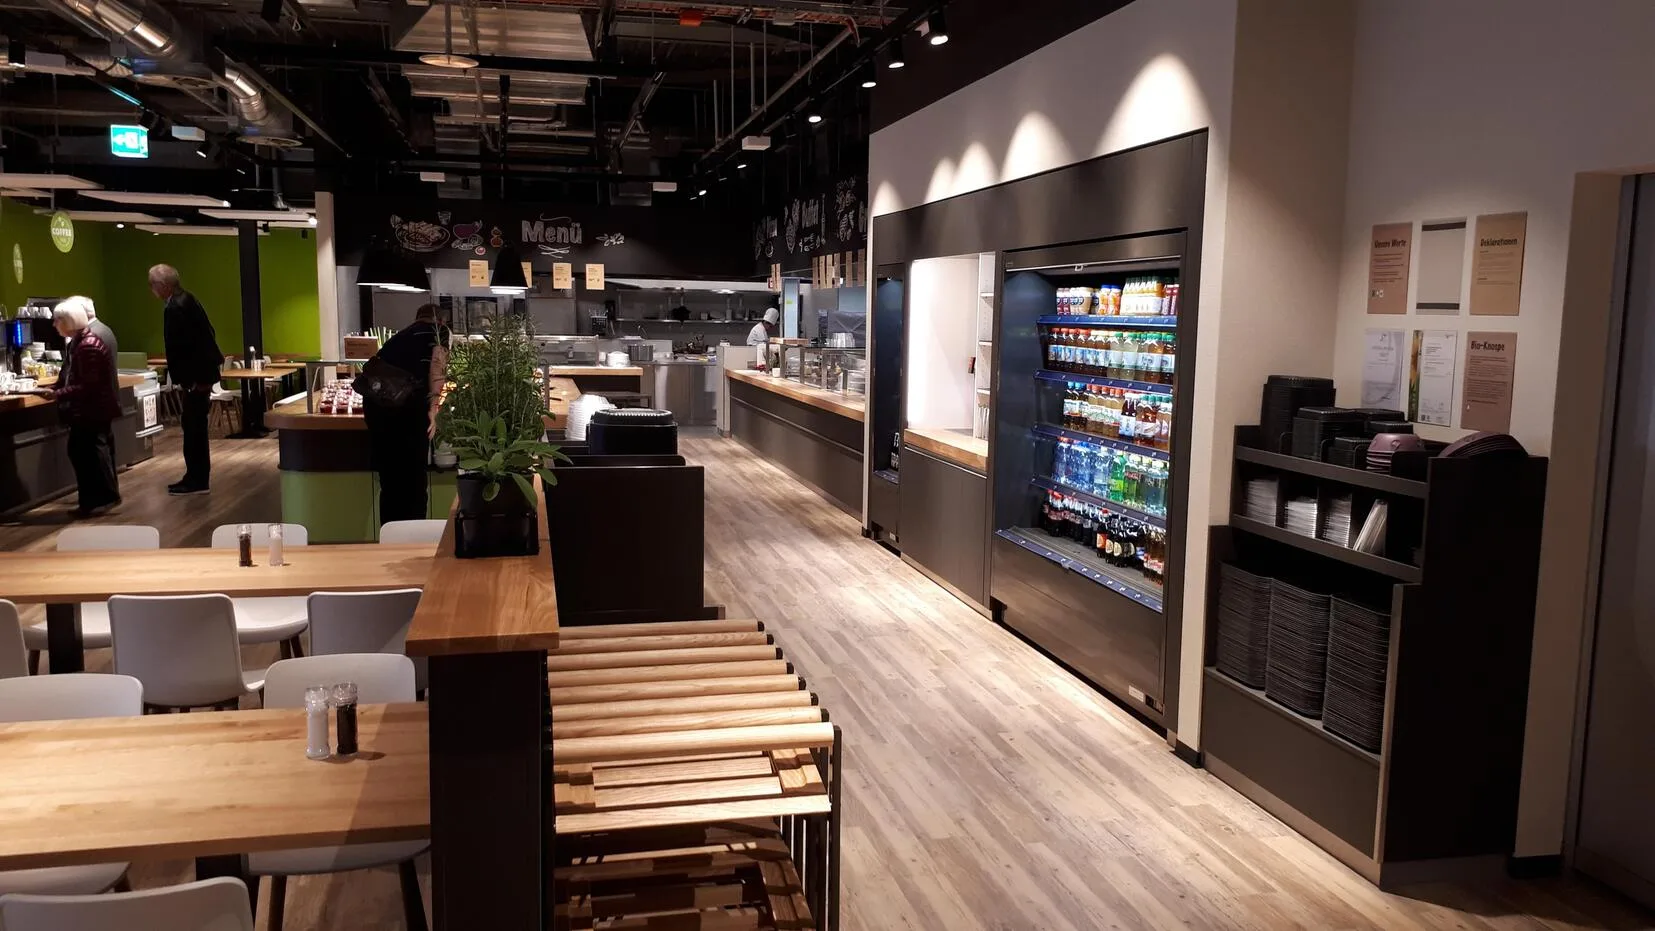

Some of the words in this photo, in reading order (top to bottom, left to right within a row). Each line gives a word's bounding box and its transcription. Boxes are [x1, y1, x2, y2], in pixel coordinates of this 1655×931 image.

[52, 227, 72, 237] COFFEE
[521, 219, 582, 244] Menü
[1470, 340, 1505, 352] Bio-Knospe
